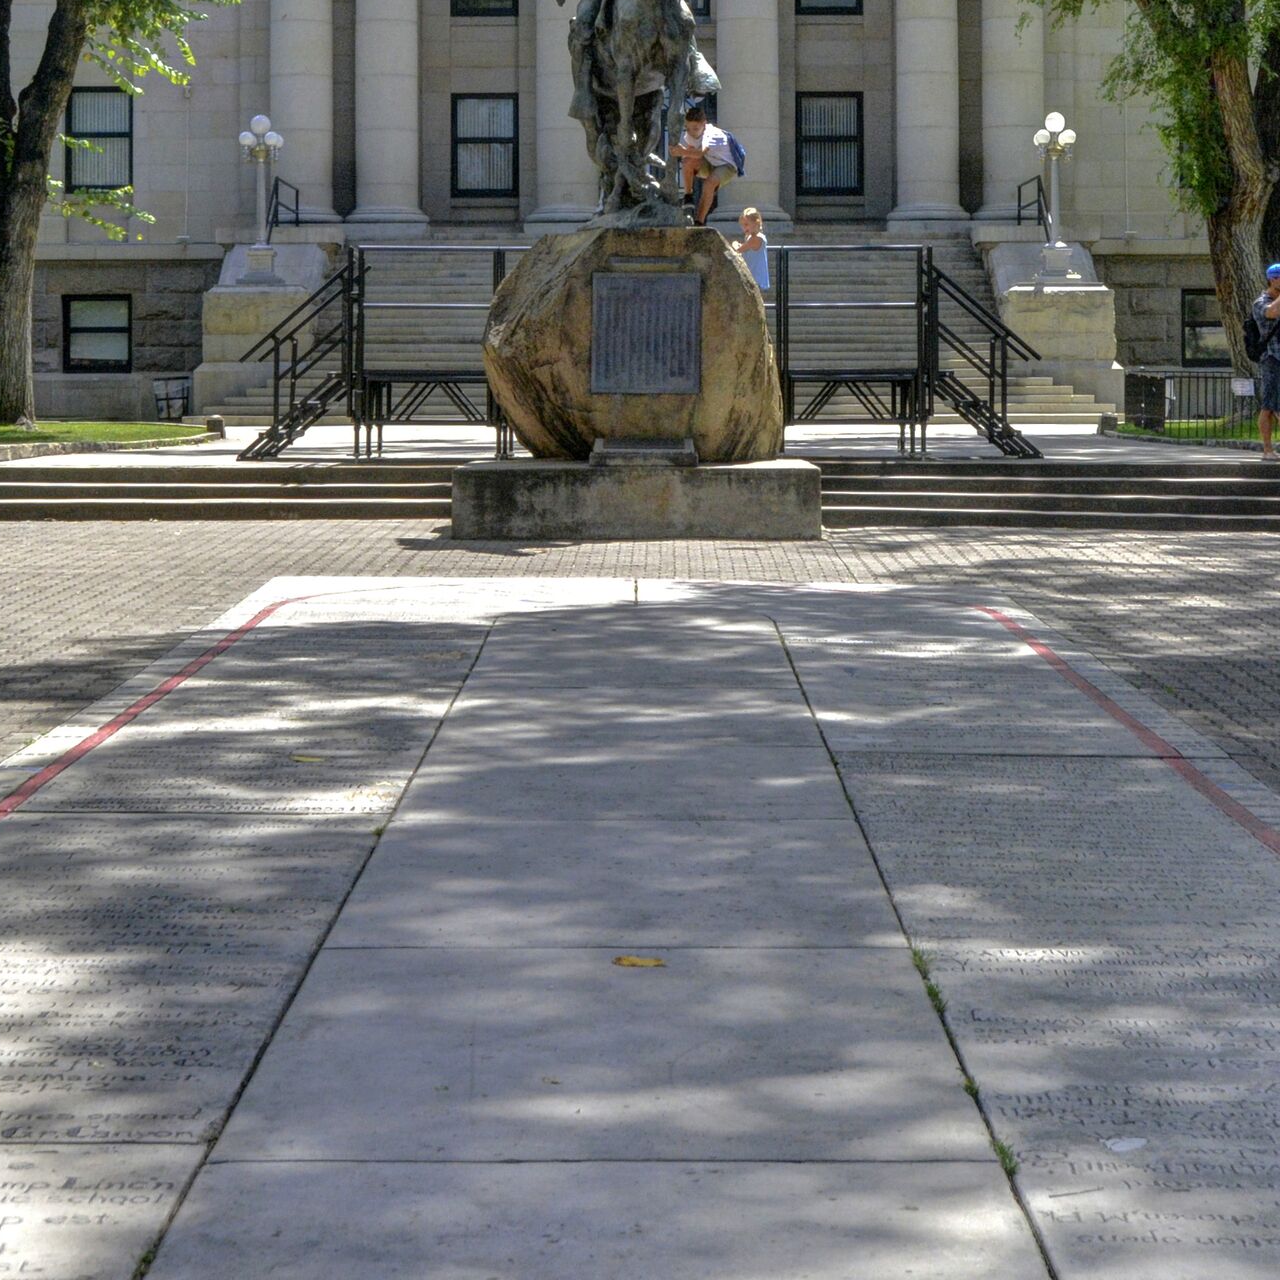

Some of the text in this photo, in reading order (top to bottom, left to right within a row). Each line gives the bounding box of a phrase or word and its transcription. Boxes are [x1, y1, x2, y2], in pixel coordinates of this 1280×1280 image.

[85, 1107, 202, 1123] opened
[64, 1124, 195, 1141] Canyon
[44, 1193, 165, 1206] school
[41, 1212, 122, 1226] est.
[1076, 1229, 1183, 1244] opens
